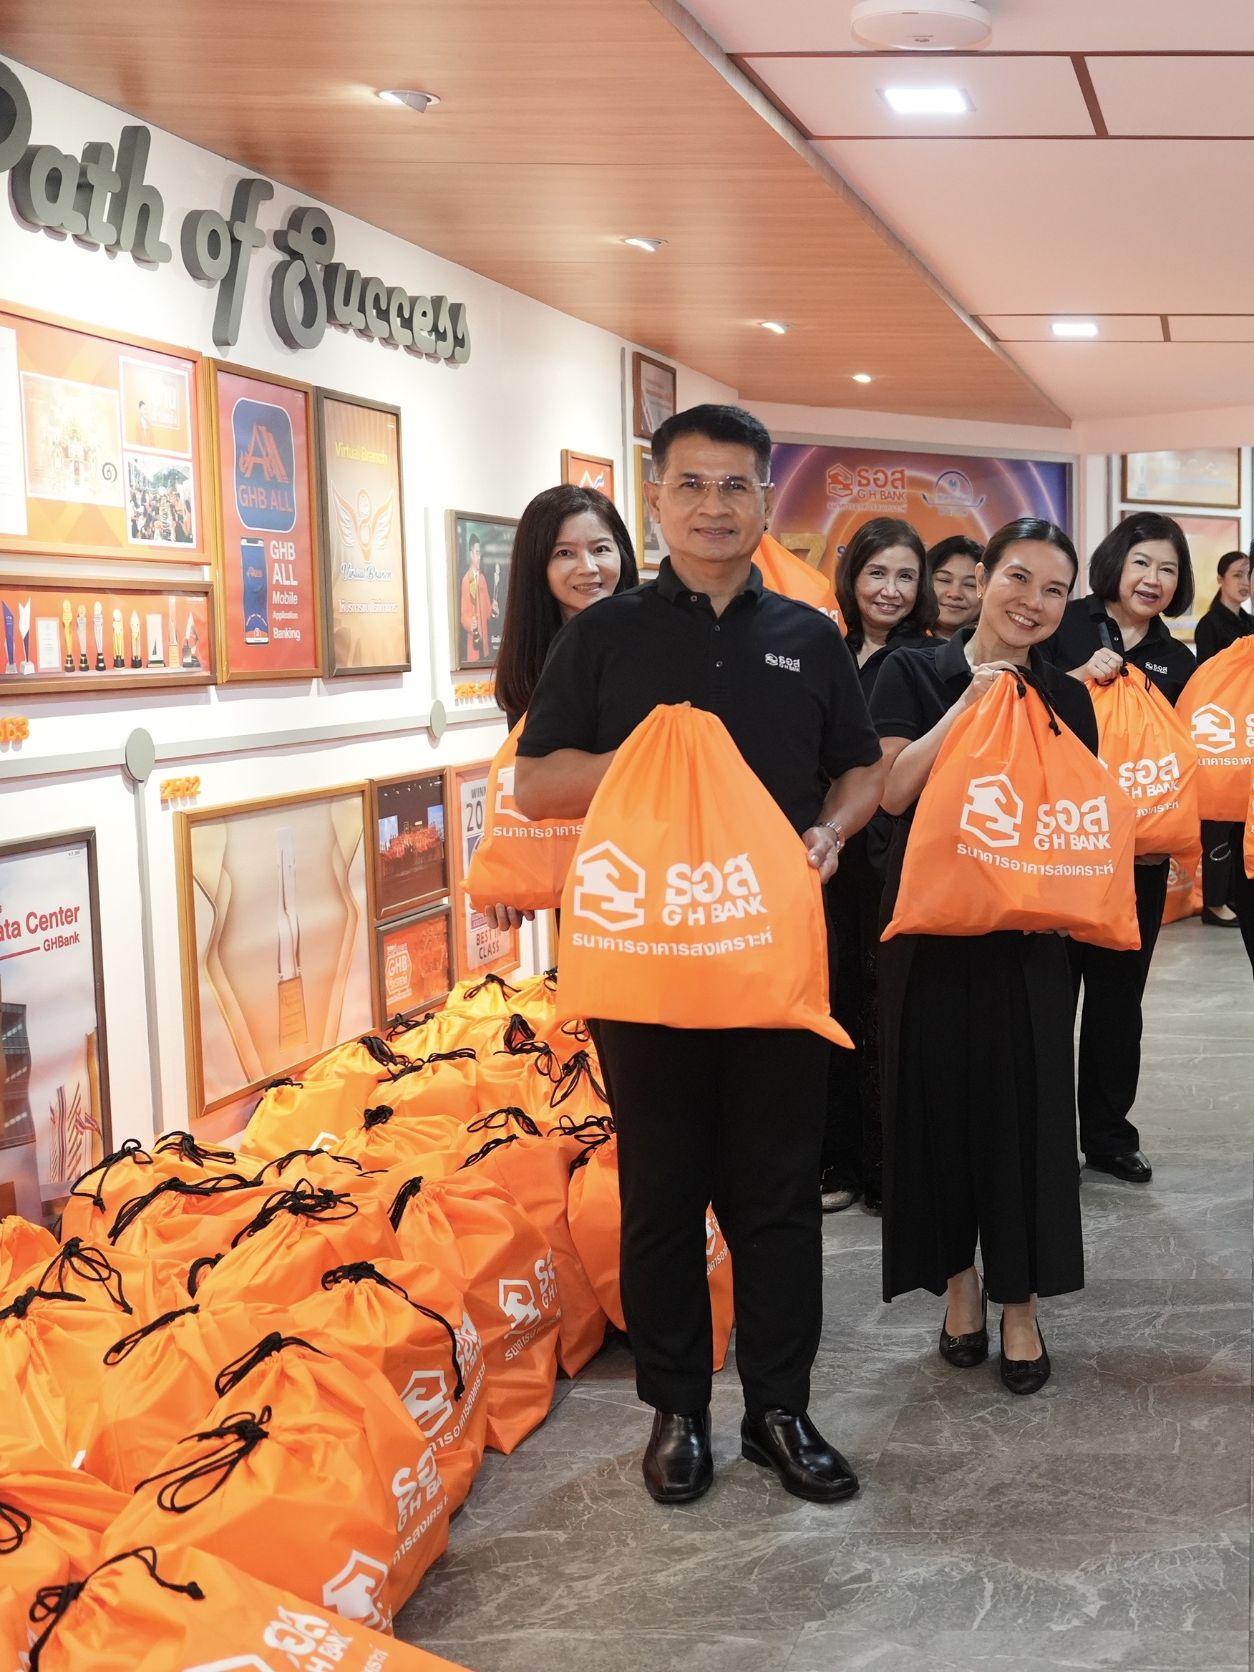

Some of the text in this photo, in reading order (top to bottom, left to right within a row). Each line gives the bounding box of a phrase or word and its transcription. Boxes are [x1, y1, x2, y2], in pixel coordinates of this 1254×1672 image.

[181, 178, 274, 346] of
[270, 207, 471, 364] Success
[857, 467, 906, 489] ธอส
[238, 484, 293, 513] GHB ALL
[880, 489, 906, 501] BANK
[270, 541, 296, 560] GHB
[272, 563, 298, 586] ALL
[272, 591, 298, 605] Mobile
[273, 627, 301, 642] Banking
[1118, 752, 1180, 787] ธอส
[1035, 795, 1111, 836] ธอส
[1070, 832, 1111, 850] BANK
[956, 842, 1114, 877] ธนาคารอาคารสงเคราะห์
[665, 853, 761, 905] ธอส
[26, 905, 80, 935] Center
[711, 894, 769, 924] BANK
[43, 931, 80, 952] GHBank
[476, 928, 493, 946] BEST
[572, 925, 773, 957] ธนาคารอาคารสงเคราะห์
[479, 941, 500, 960] CLASS
